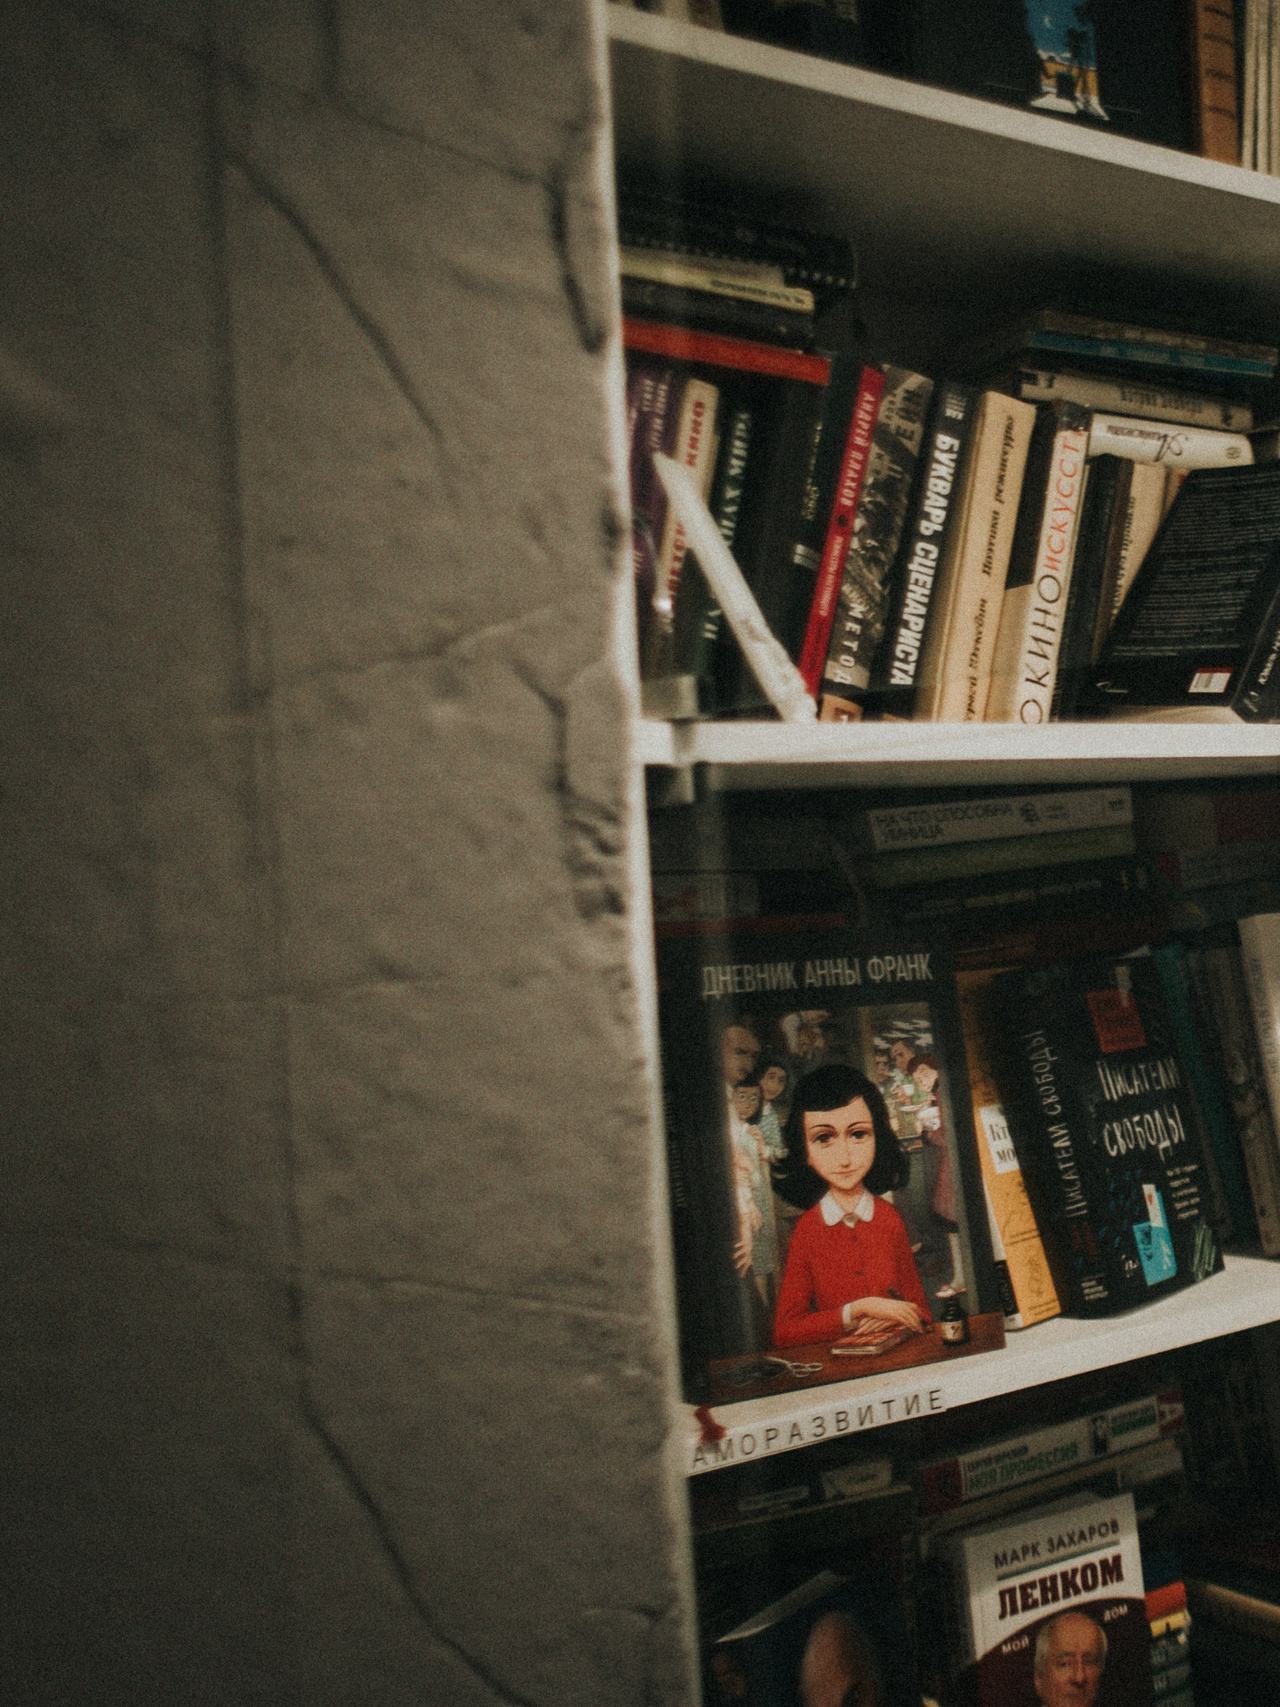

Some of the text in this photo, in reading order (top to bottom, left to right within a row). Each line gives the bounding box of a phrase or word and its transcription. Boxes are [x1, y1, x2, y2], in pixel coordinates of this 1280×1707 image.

[852, 392, 874, 446] АНДРЕЙ
[840, 451, 863, 508] ПЛАХОВ
[918, 435, 959, 536] БУКВАРЬ
[891, 540, 938, 686] СЦЕНАРИСТА
[963, 673, 978, 722] ергей
[981, 510, 999, 577] Поэтика
[834, 605, 866, 685] МЕТОД
[701, 951, 934, 1000] ДНЕВНИК АННЫ ФРАНК
[1102, 1105, 1187, 1164] свободы
[693, 1388, 944, 1467] АМОРАЗВИТИЕ
[994, 1518, 1120, 1570] МАРК ЗАХАРОВ
[998, 1554, 1124, 1621] ЛЕНКОМ
[1002, 1605, 1128, 1654] МОЙ ДОМ
